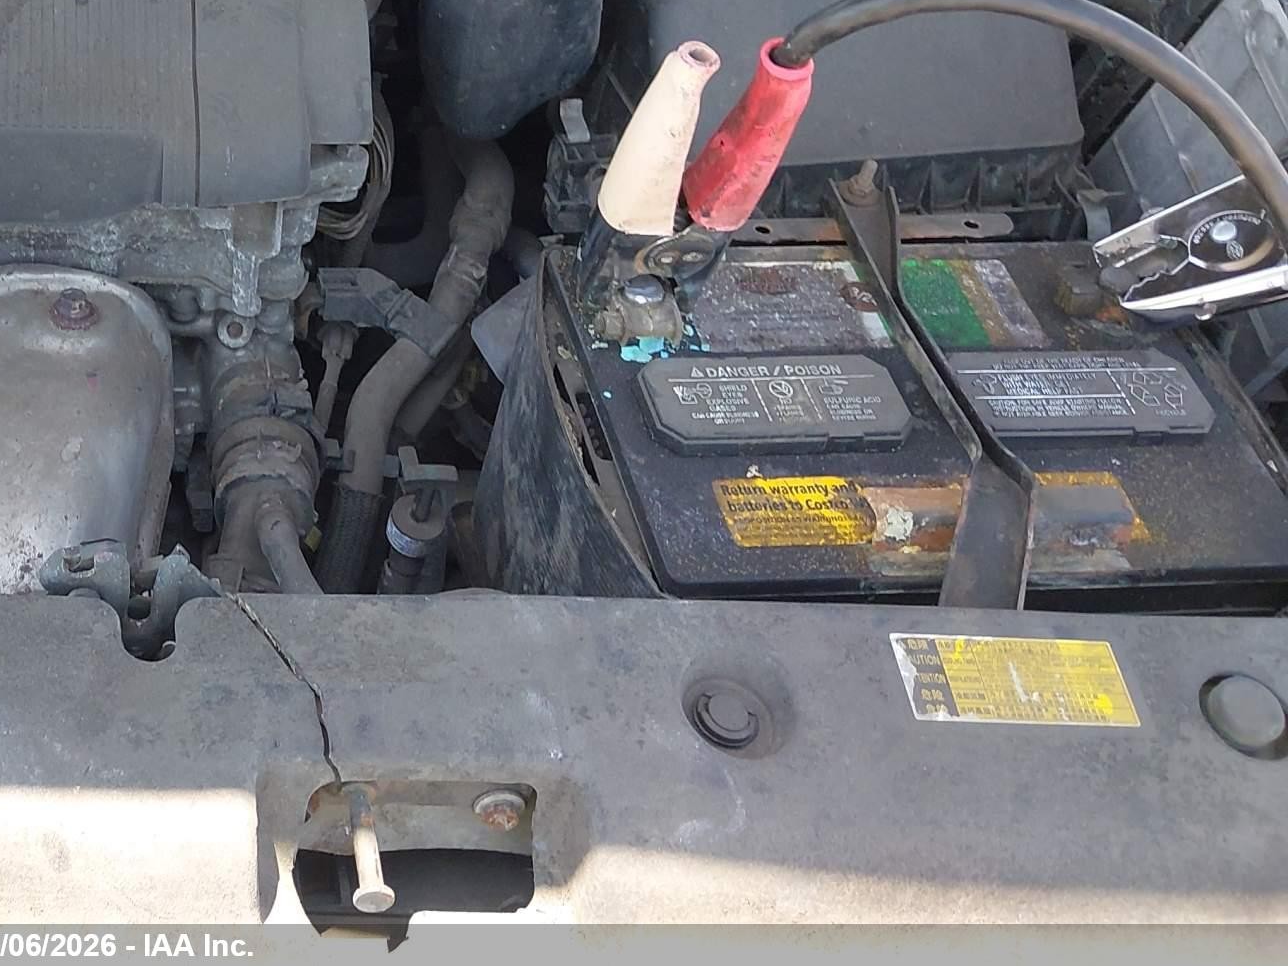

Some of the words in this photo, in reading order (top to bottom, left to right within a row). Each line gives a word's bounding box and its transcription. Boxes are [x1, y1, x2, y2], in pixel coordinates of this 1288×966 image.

[705, 365, 770, 378] DANGER
[783, 364, 842, 377] POISON
[1047, 372, 1097, 380] IMMEDIATELY
[719, 384, 748, 392] SHIELD
[823, 396, 862, 404] SULFURIC
[719, 484, 767, 496] Return
[769, 482, 829, 497] warranty
[831, 480, 857, 494] and
[727, 499, 787, 513] batteries
[789, 500, 804, 511] to
[805, 499, 849, 511] Costco
[909, 654, 941, 666] AUTION
